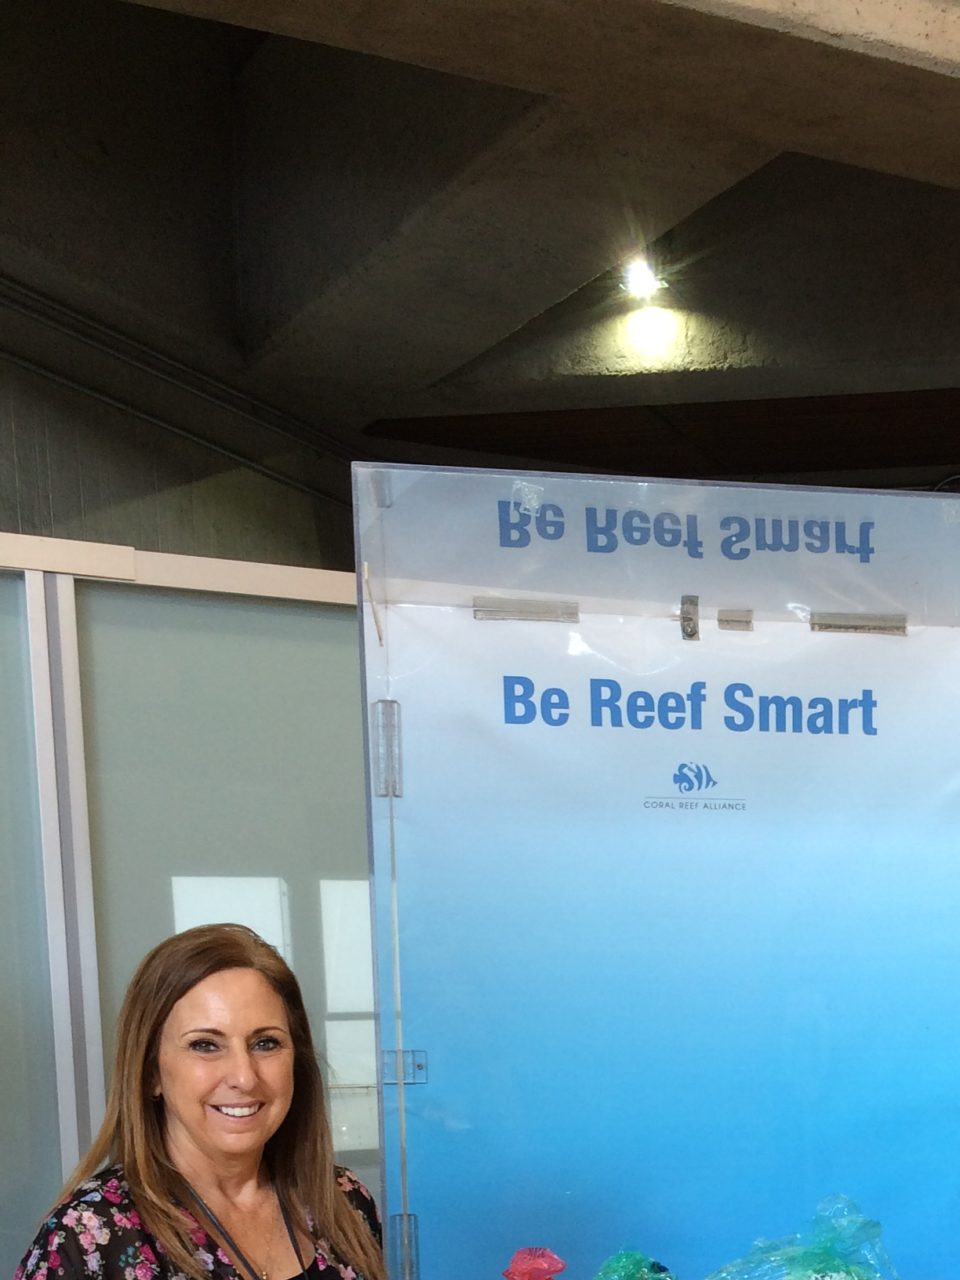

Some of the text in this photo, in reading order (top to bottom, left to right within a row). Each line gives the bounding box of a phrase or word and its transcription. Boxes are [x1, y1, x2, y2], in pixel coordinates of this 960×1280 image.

[503, 675, 878, 736] Be Reef Smart
[643, 801, 747, 811] CORAL REEF ALLIANCE
